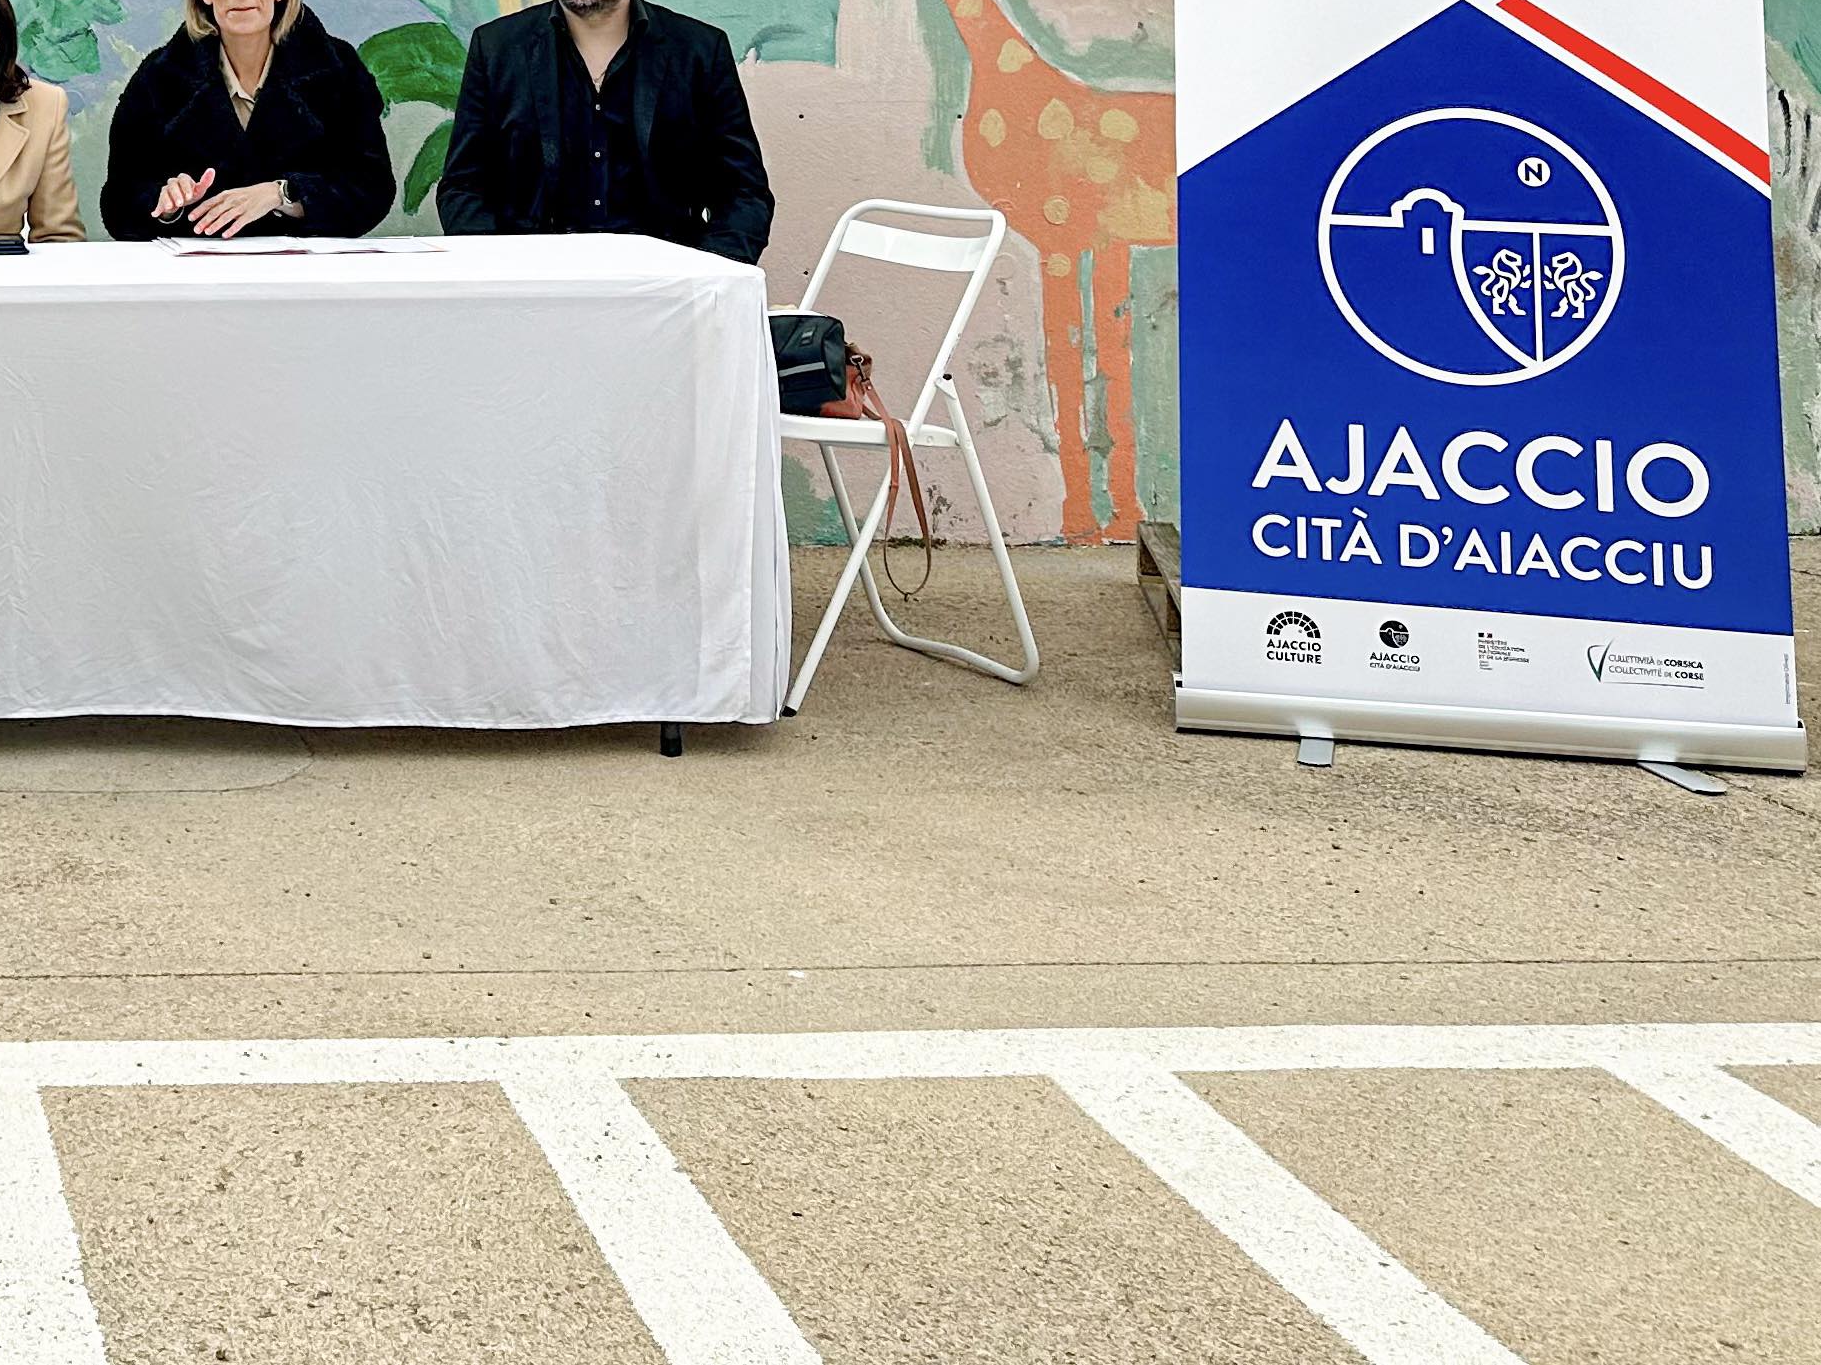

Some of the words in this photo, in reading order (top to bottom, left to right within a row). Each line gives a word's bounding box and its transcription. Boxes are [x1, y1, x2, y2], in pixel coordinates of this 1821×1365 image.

[1524, 161, 1544, 183] N
[1251, 418, 1710, 519] AJACCIO
[1251, 510, 1383, 566] CITÀ
[1399, 523, 1714, 591] D'AIACCIU
[1266, 638, 1322, 652] AJACCIO
[1266, 650, 1322, 664] CULTURE
[1370, 651, 1420, 664] AJACCIO
[1664, 658, 1704, 669] CORSICA
[1674, 671, 1705, 681] CORSE
